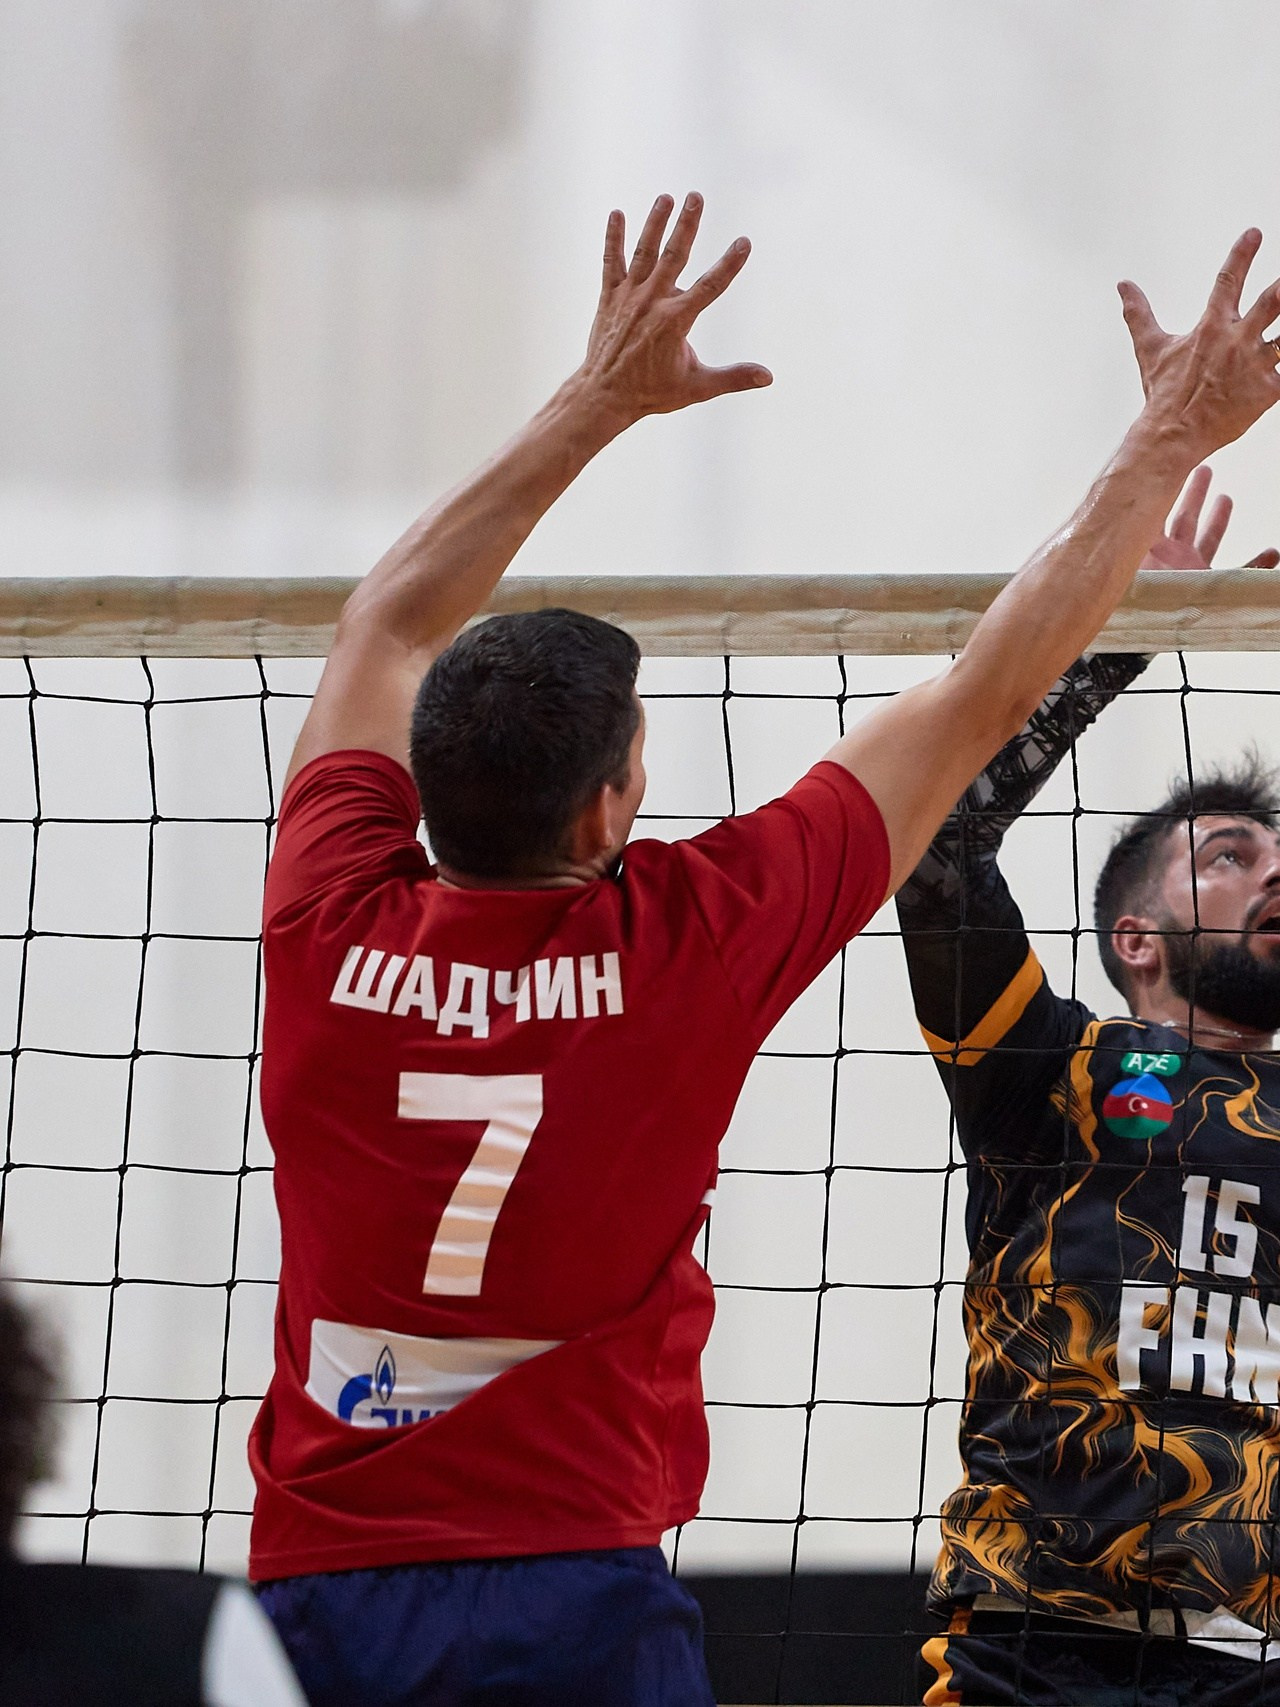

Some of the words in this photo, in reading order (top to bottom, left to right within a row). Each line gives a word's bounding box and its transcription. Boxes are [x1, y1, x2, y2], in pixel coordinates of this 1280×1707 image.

[330, 945, 625, 1038] ШАДЧИН
[397, 1072, 544, 1297] 7
[1174, 1175, 1261, 1278] 15
